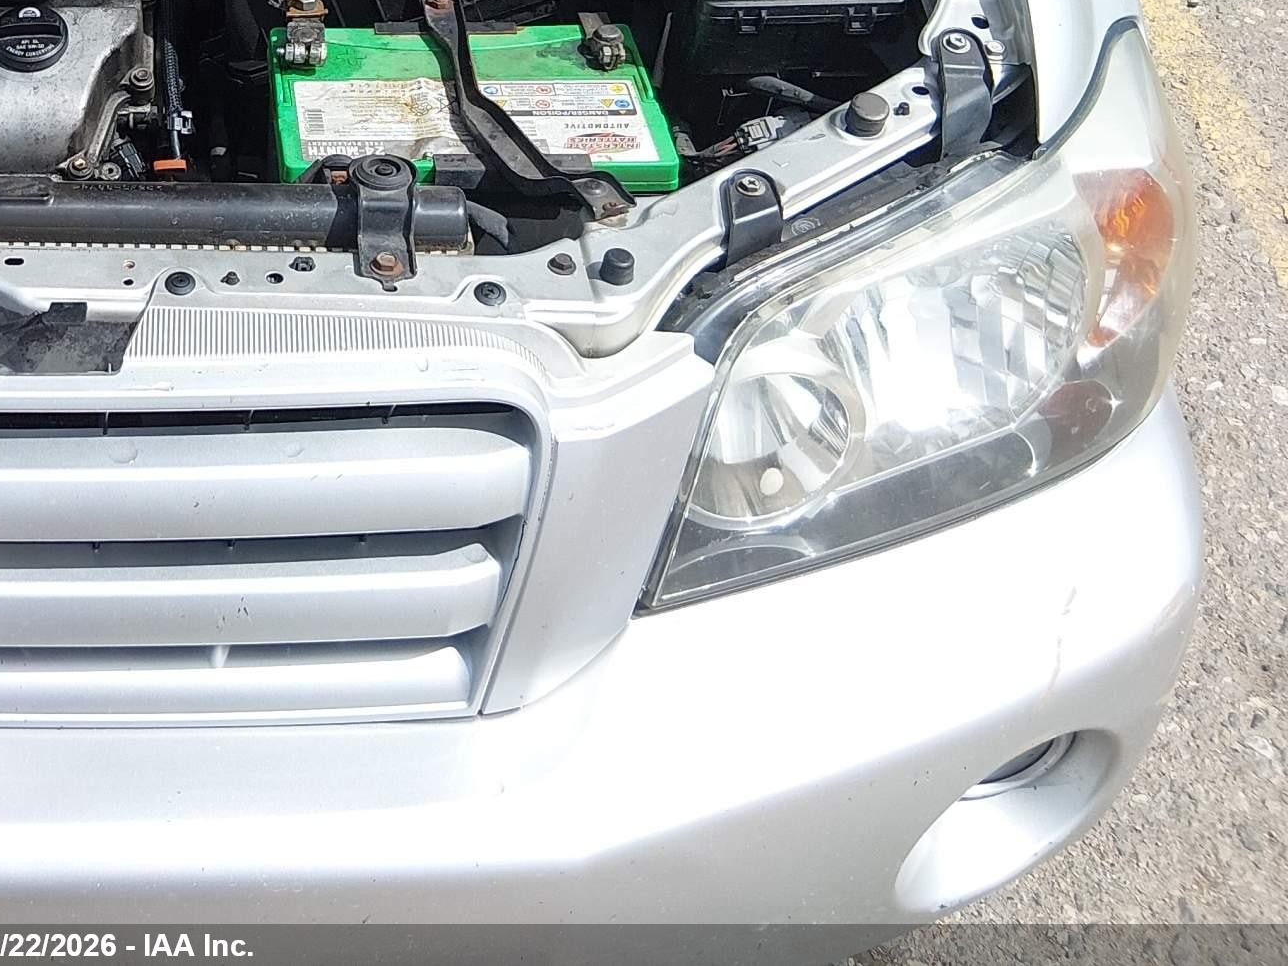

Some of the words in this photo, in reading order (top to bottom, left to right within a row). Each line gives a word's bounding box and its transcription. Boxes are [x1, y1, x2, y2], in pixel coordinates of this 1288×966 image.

[563, 122, 630, 130] AUTOMOTIVE
[564, 142, 641, 150] INTERSTATE
[307, 145, 386, 156] 24-MONTH
